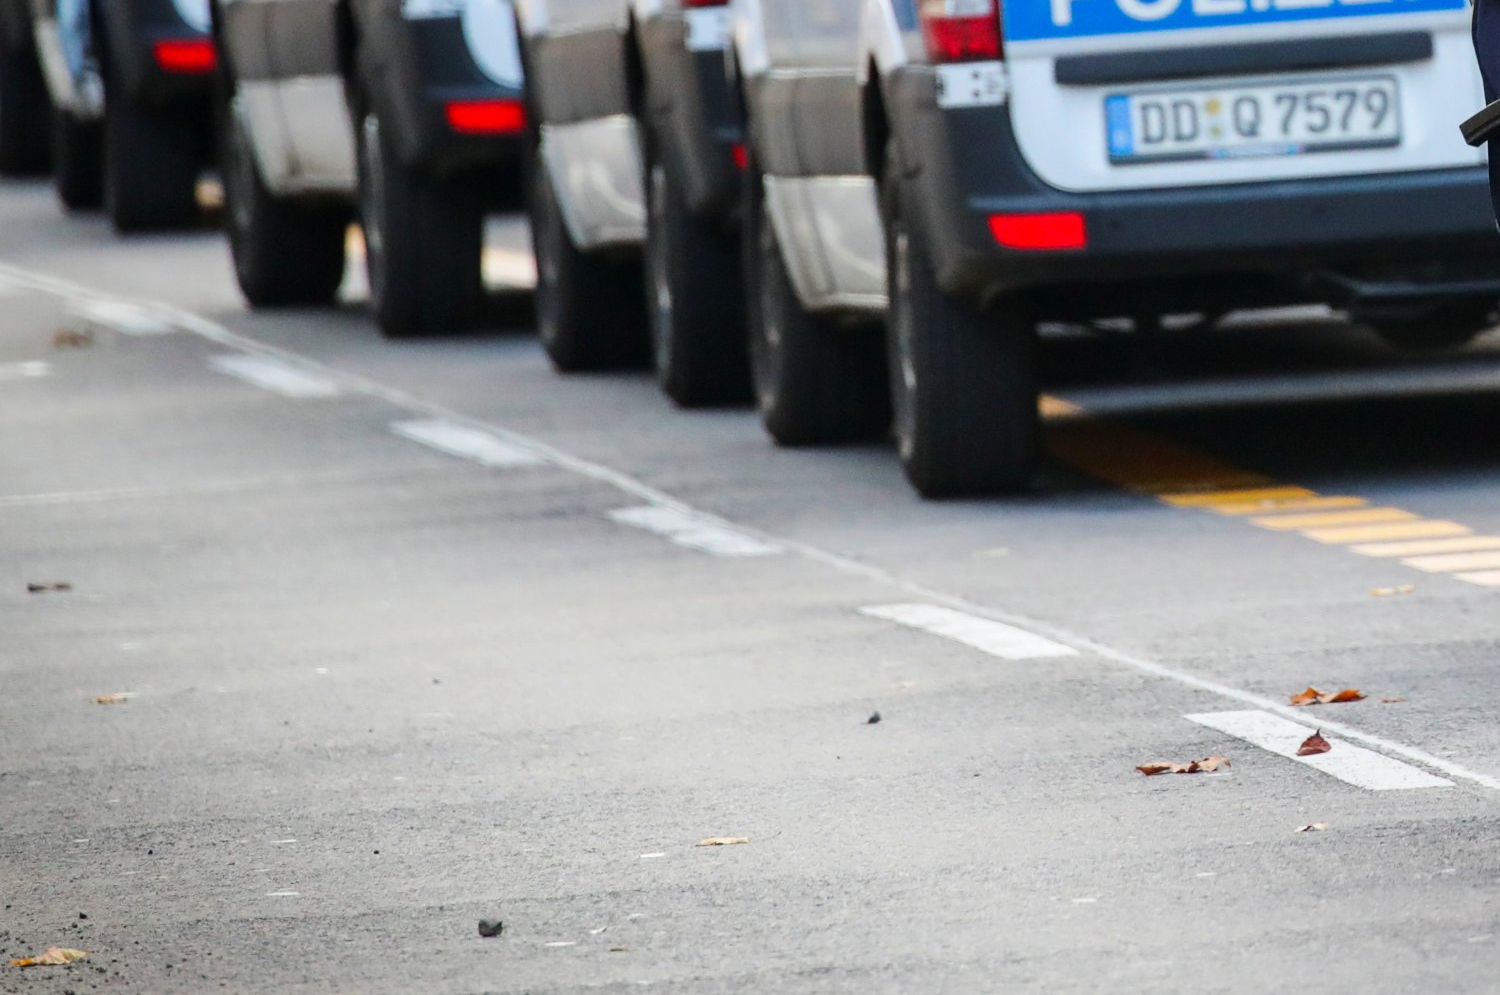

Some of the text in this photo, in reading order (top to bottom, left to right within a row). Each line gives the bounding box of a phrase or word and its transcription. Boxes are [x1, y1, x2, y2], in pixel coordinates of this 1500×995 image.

[1141, 101, 1199, 144] DD
[1232, 96, 1259, 137] Q
[1275, 87, 1389, 135] 7579
